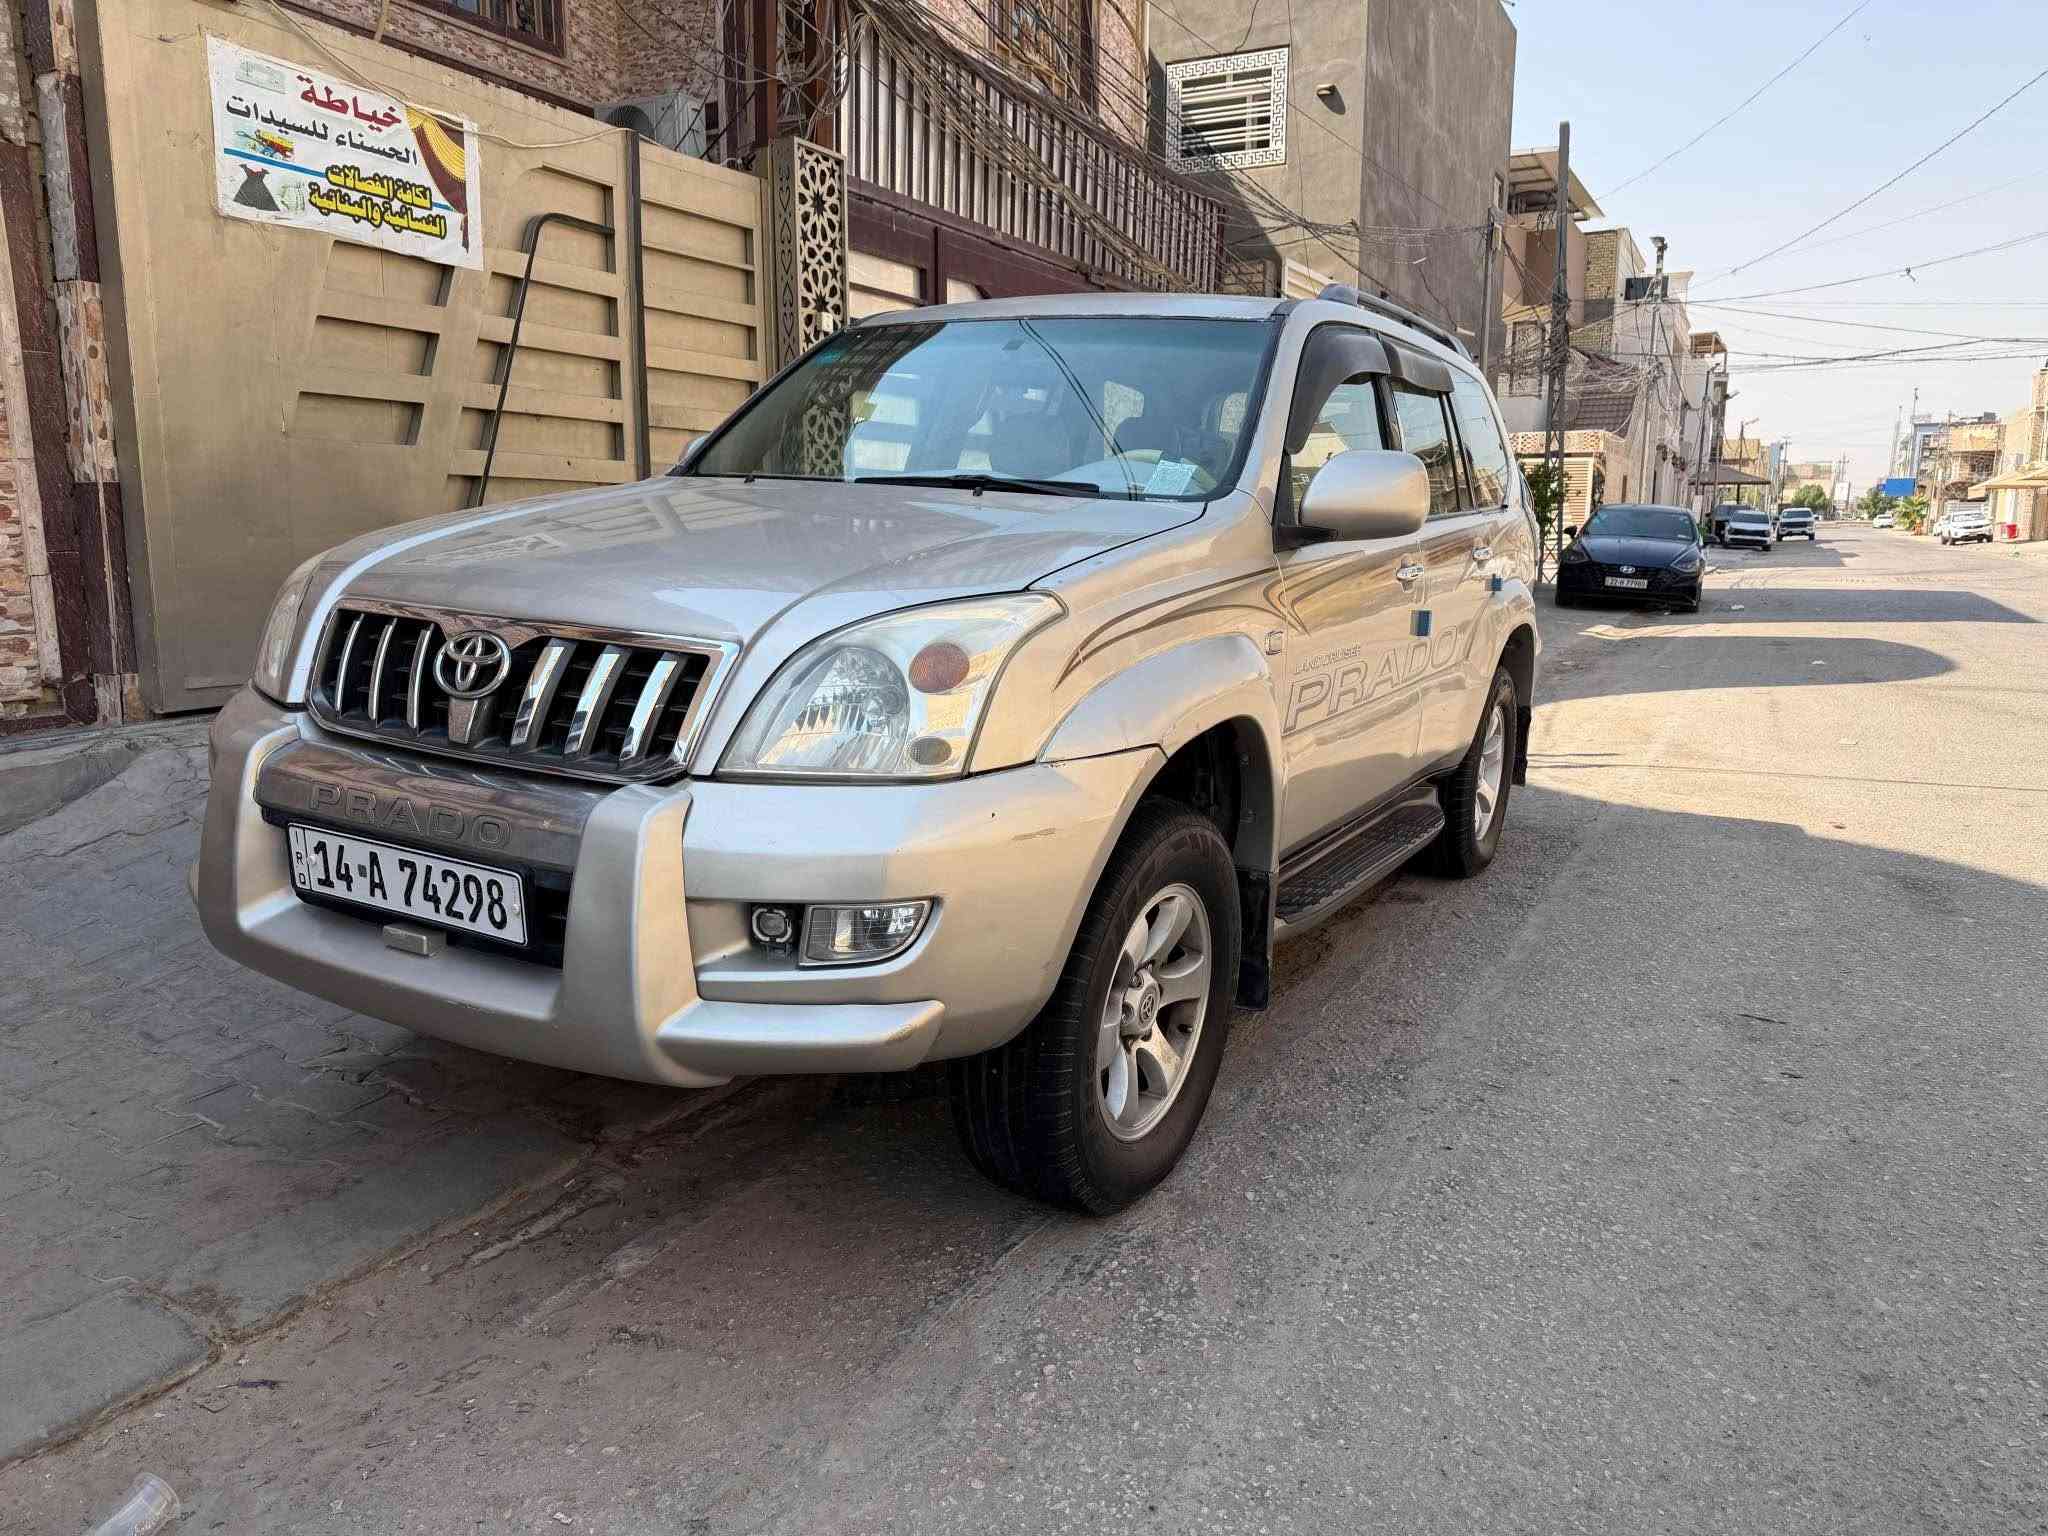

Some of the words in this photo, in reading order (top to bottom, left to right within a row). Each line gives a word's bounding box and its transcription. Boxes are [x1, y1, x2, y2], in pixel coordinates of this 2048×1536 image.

[226, 95, 329, 140] للسيدات
[297, 74, 401, 132] خياطة
[335, 130, 417, 165] الحسناء
[1281, 626, 1457, 737] PRADO
[309, 782, 513, 849] PRADO
[398, 858, 508, 930] 74298
